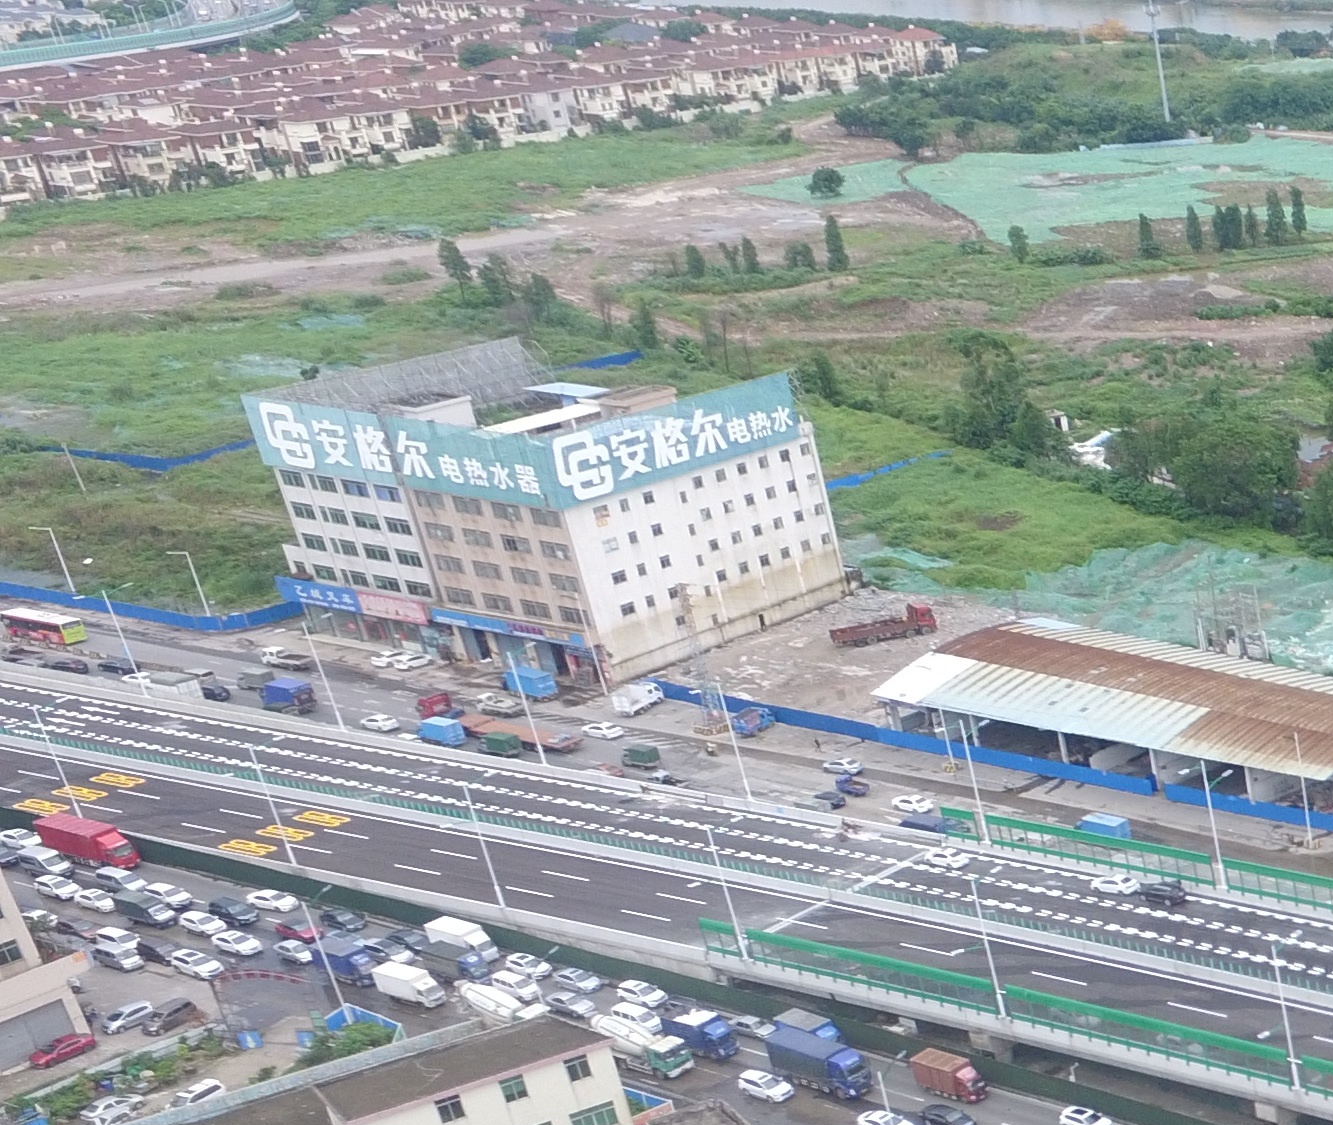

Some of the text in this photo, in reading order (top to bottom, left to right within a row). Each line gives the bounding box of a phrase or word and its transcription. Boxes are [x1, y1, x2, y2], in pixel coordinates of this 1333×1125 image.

[311, 419, 542, 497] 安格尔 电热水器
[609, 405, 794, 481] 安格尔 电热水
